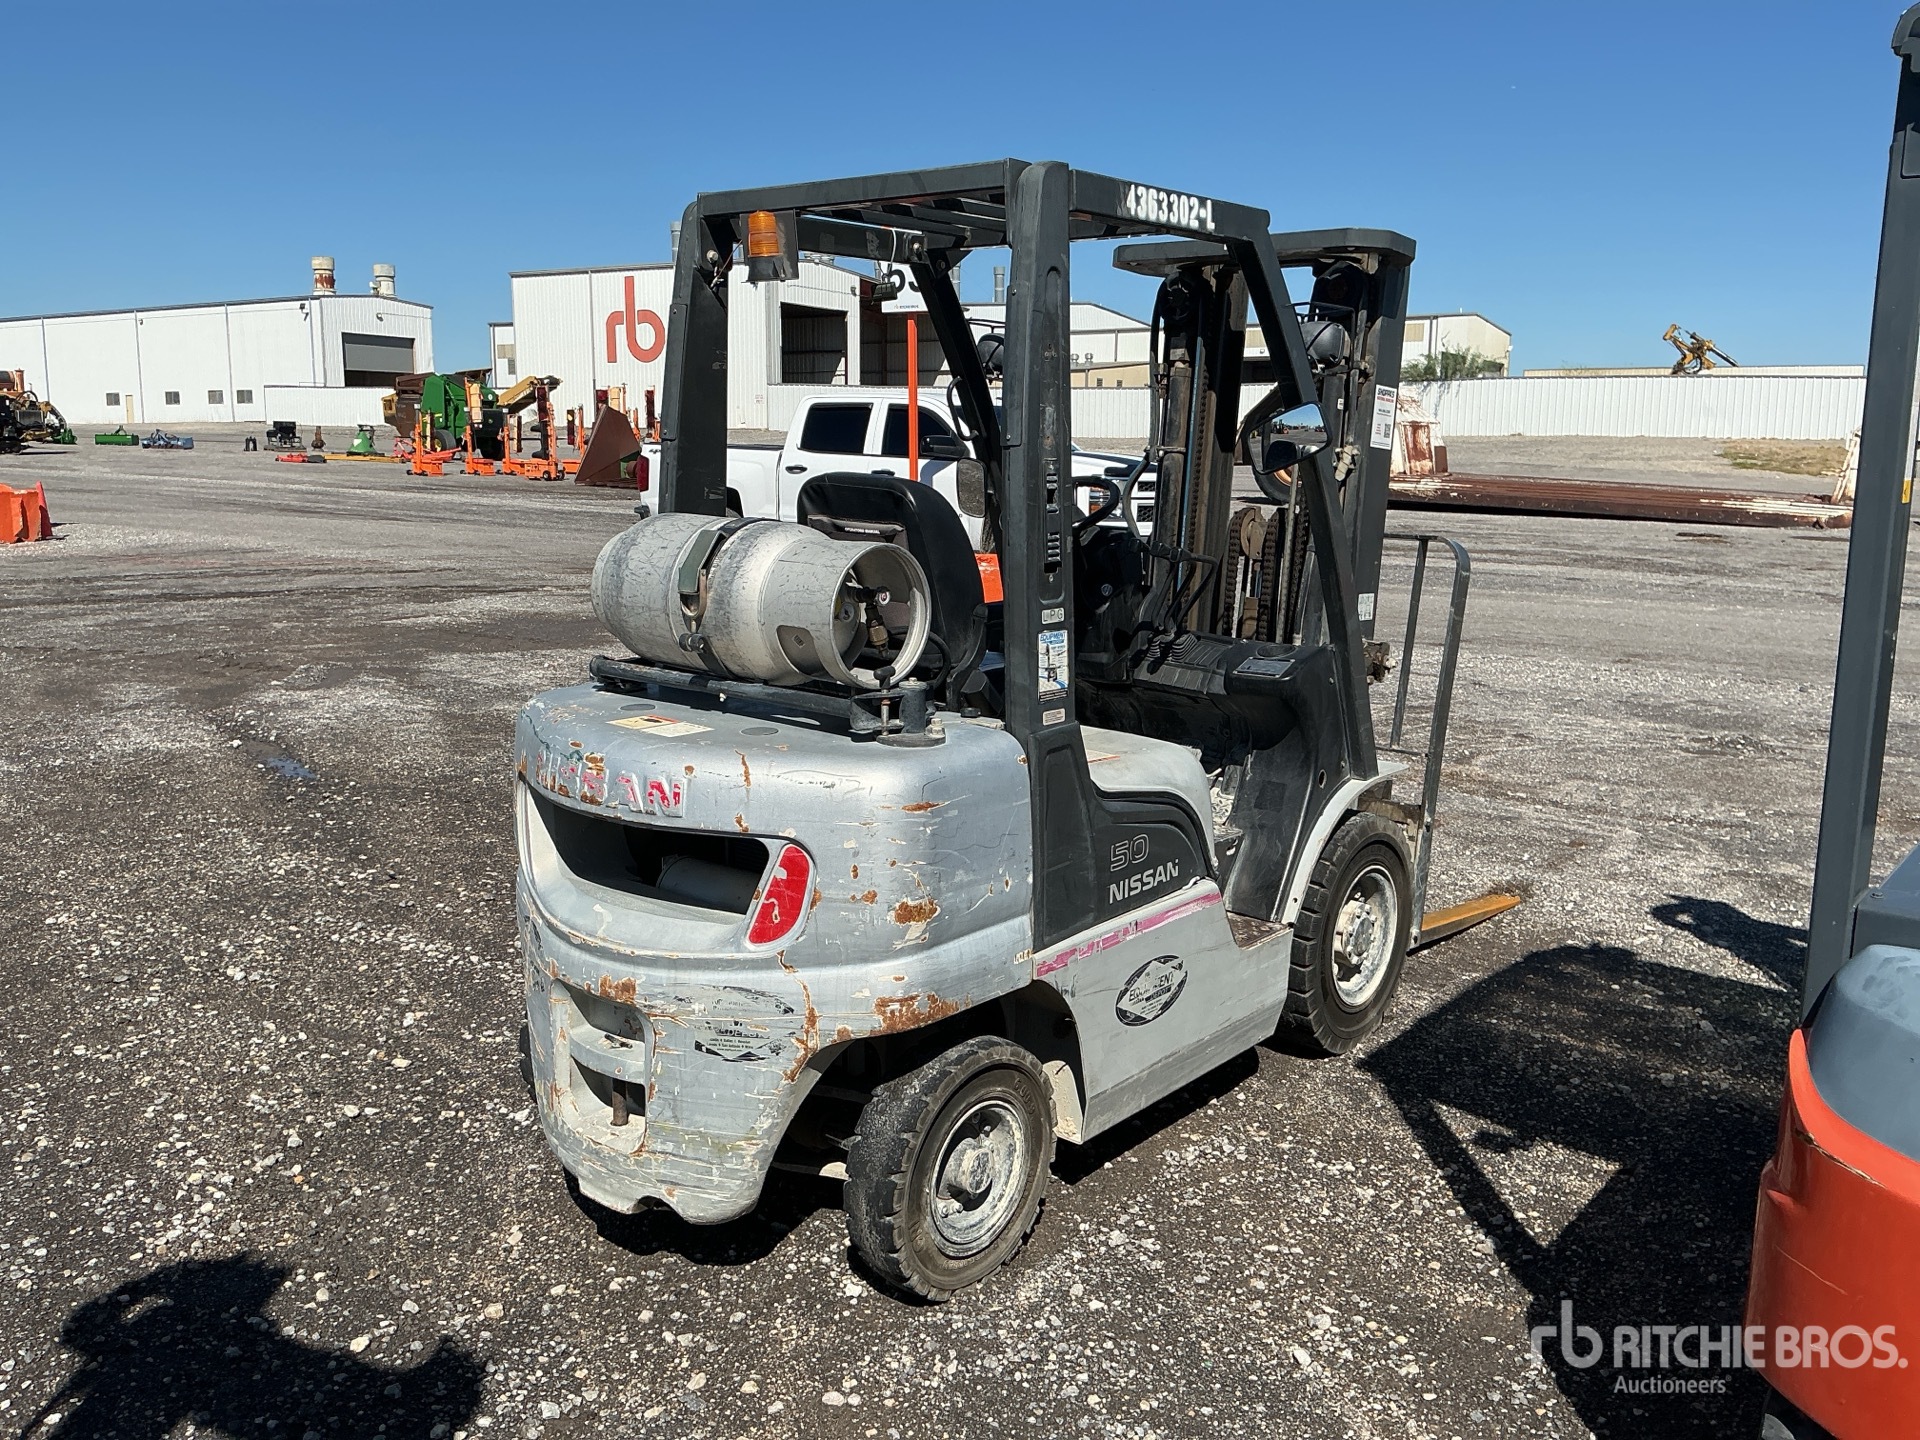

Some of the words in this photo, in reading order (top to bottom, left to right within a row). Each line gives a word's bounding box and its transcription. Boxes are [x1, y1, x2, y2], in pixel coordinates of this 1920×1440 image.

[1127, 184, 1215, 230] 4363302-L
[606, 275, 666, 363] rb
[1043, 609, 1063, 622] LPG
[1110, 833, 1150, 872] 50
[1109, 858, 1179, 905] NISSAN
